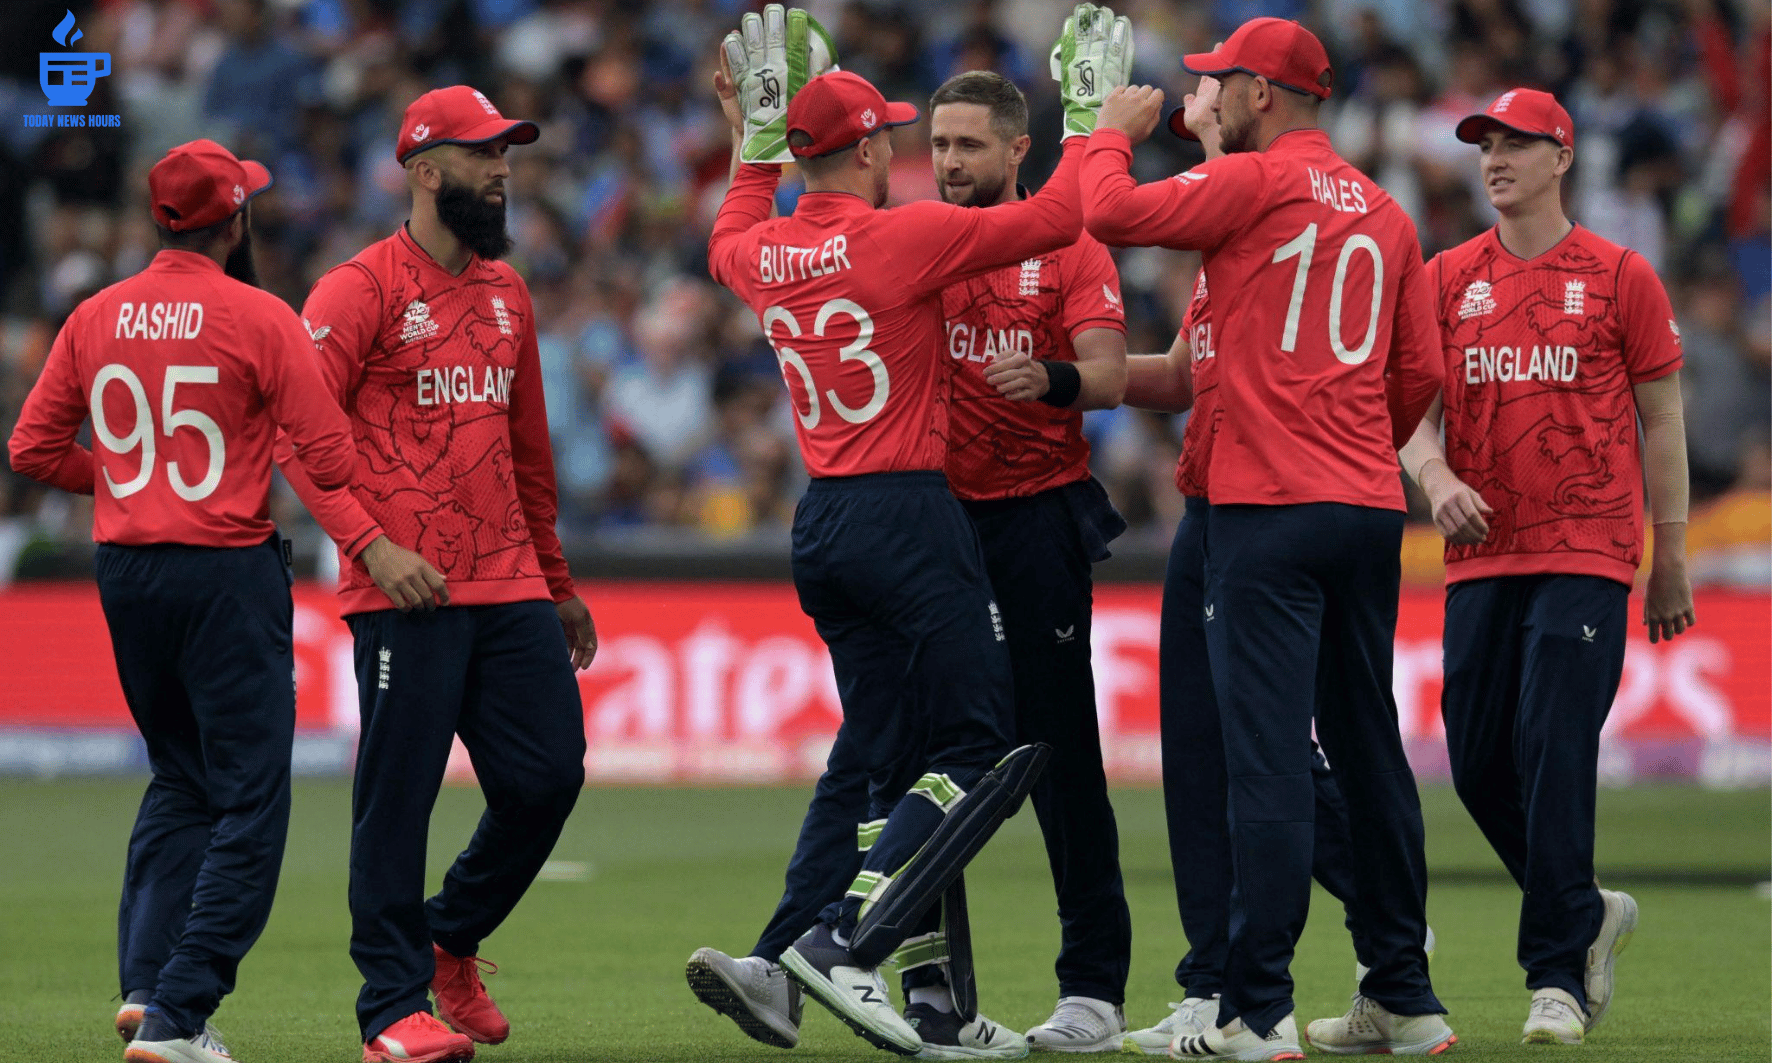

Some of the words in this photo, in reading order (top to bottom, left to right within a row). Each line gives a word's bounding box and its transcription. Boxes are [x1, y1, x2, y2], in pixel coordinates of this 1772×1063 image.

[1307, 167, 1368, 215] HALES
[760, 234, 851, 283] BUTTLER
[1272, 222, 1384, 365] 10
[115, 302, 204, 341] RASHID
[400, 328, 426, 340] WORLD
[427, 323, 439, 332] CUP
[402, 323, 424, 334] MEN'S
[946, 321, 1033, 363] GLAND
[763, 298, 890, 430] 63
[1465, 344, 1578, 385] ENGLAND
[90, 363, 226, 502] 95
[965, 1021, 997, 1045] N
